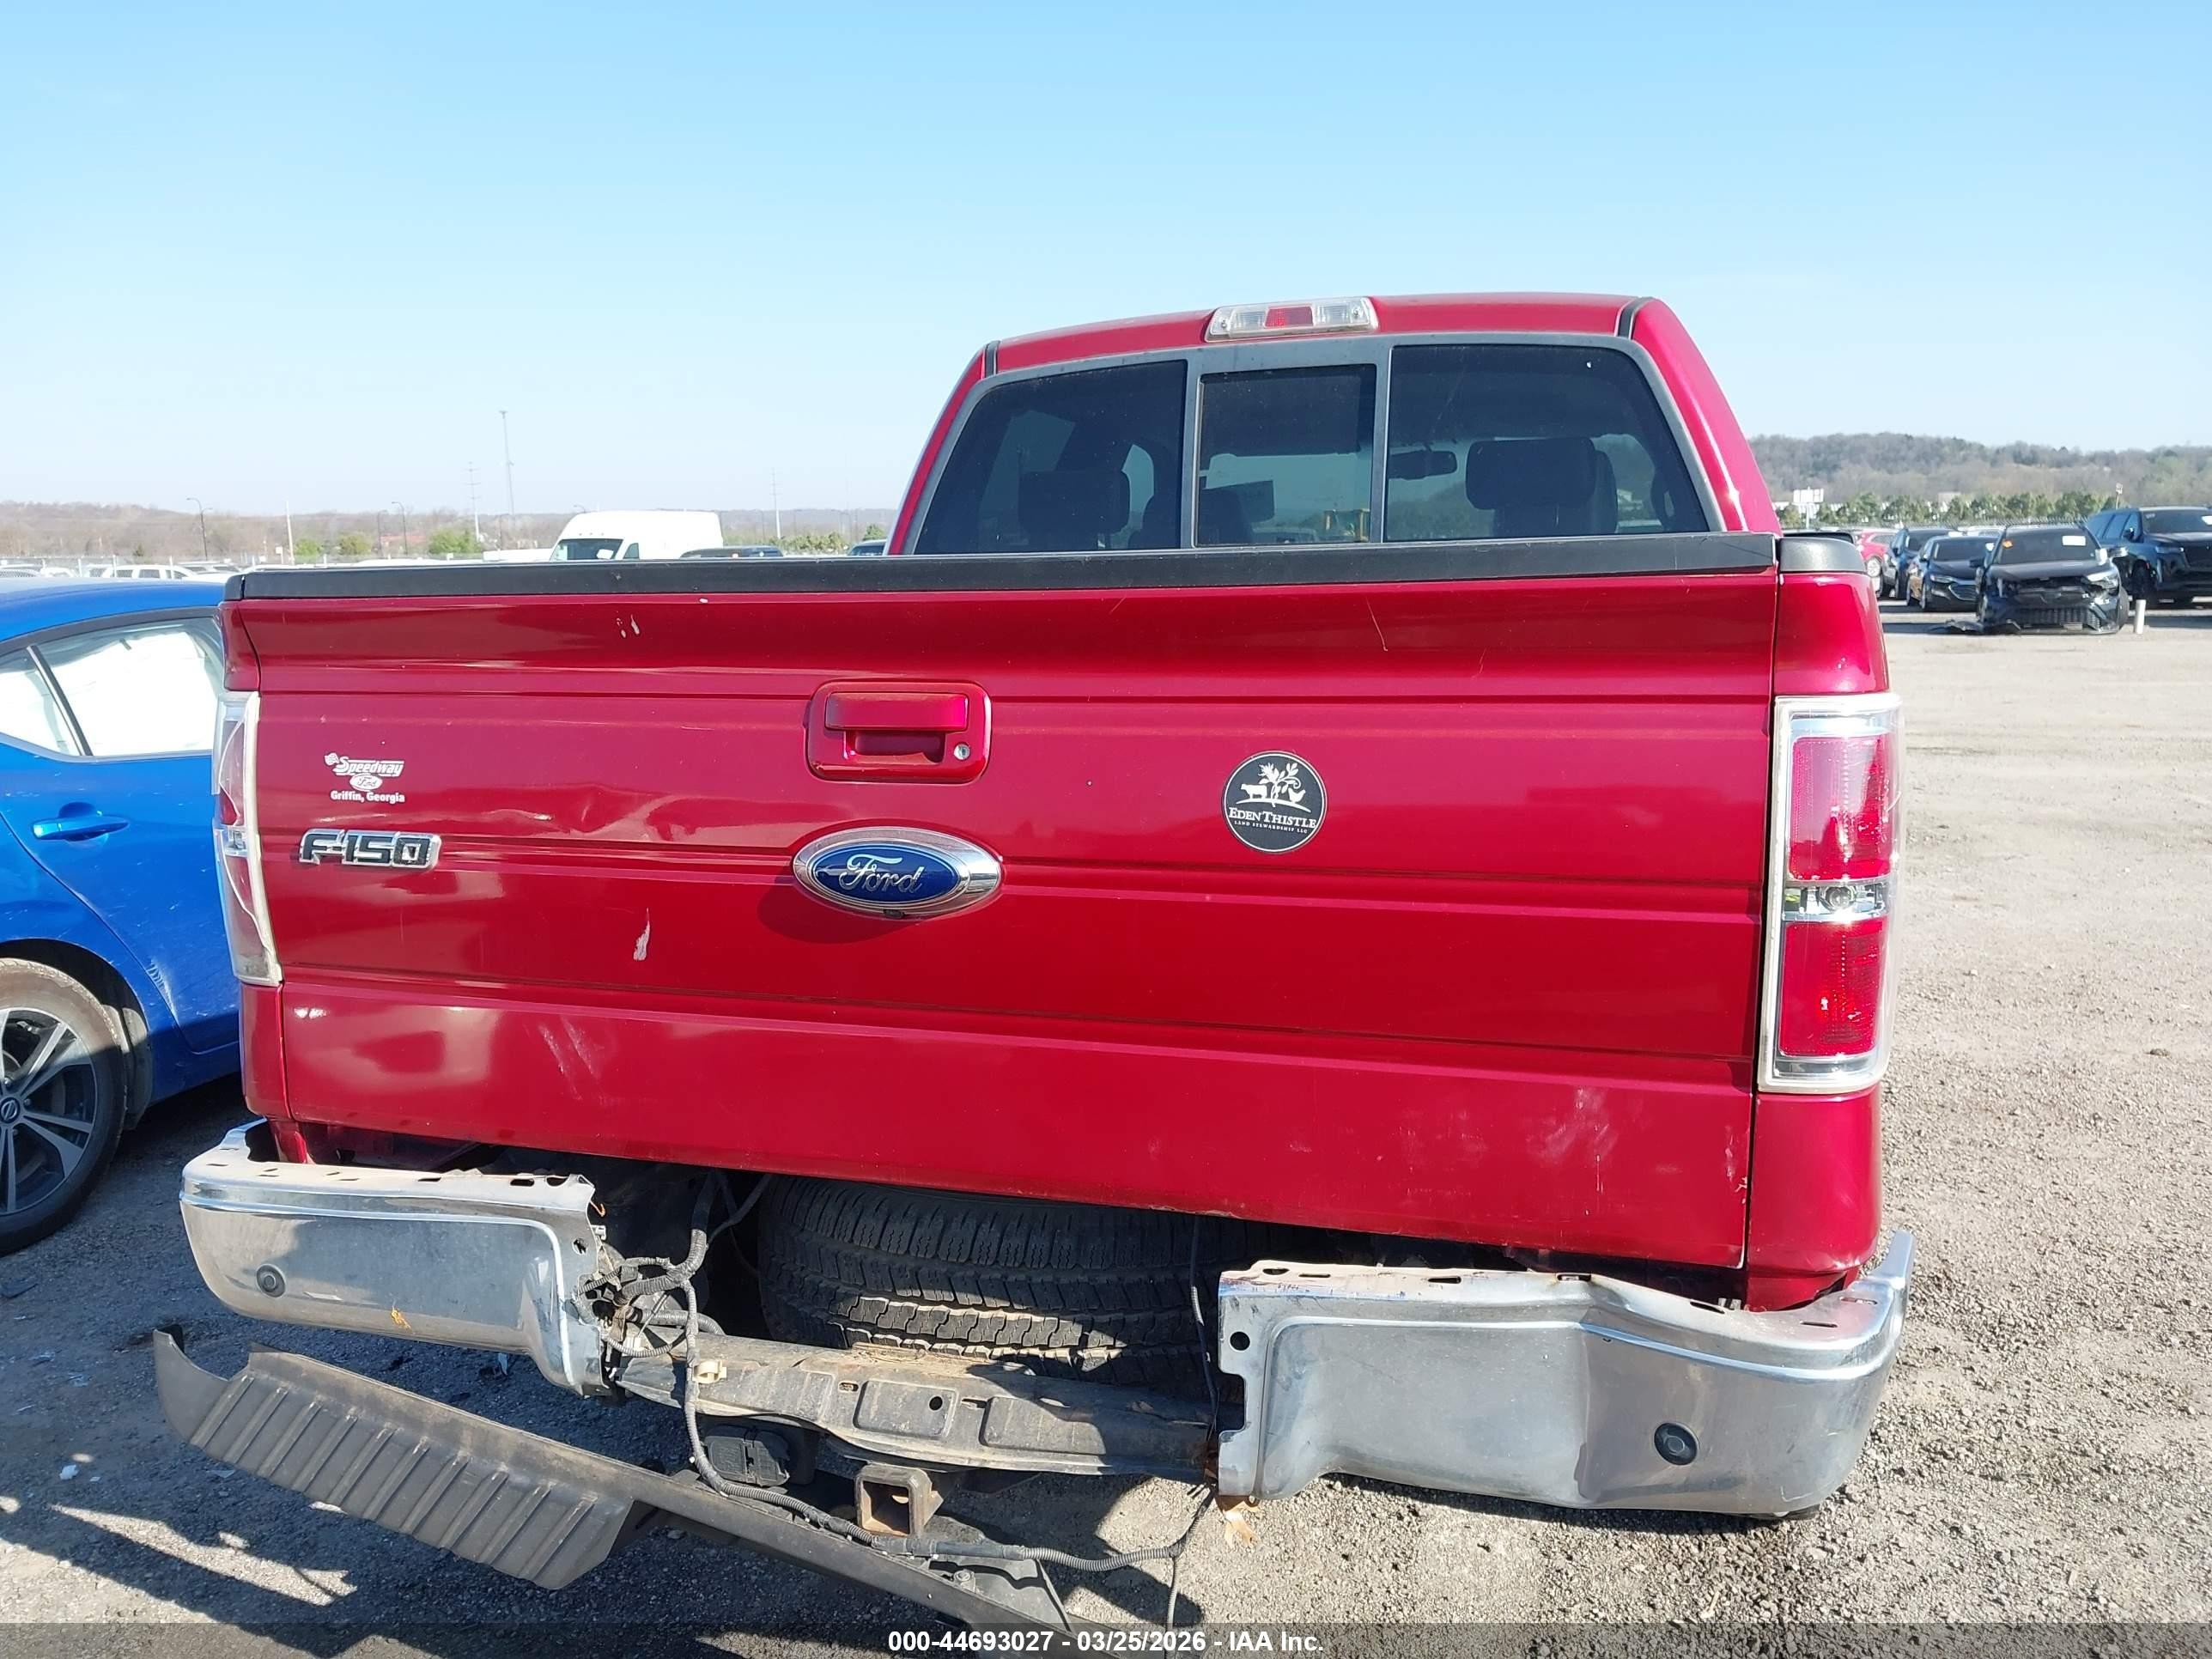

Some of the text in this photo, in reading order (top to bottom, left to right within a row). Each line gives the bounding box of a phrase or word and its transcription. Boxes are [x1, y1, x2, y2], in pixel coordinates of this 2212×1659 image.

[332, 757, 404, 777] Speedway
[330, 790, 405, 805] Griffin, Georgia
[300, 829, 441, 870] F-150
[838, 854, 924, 893] Ford
